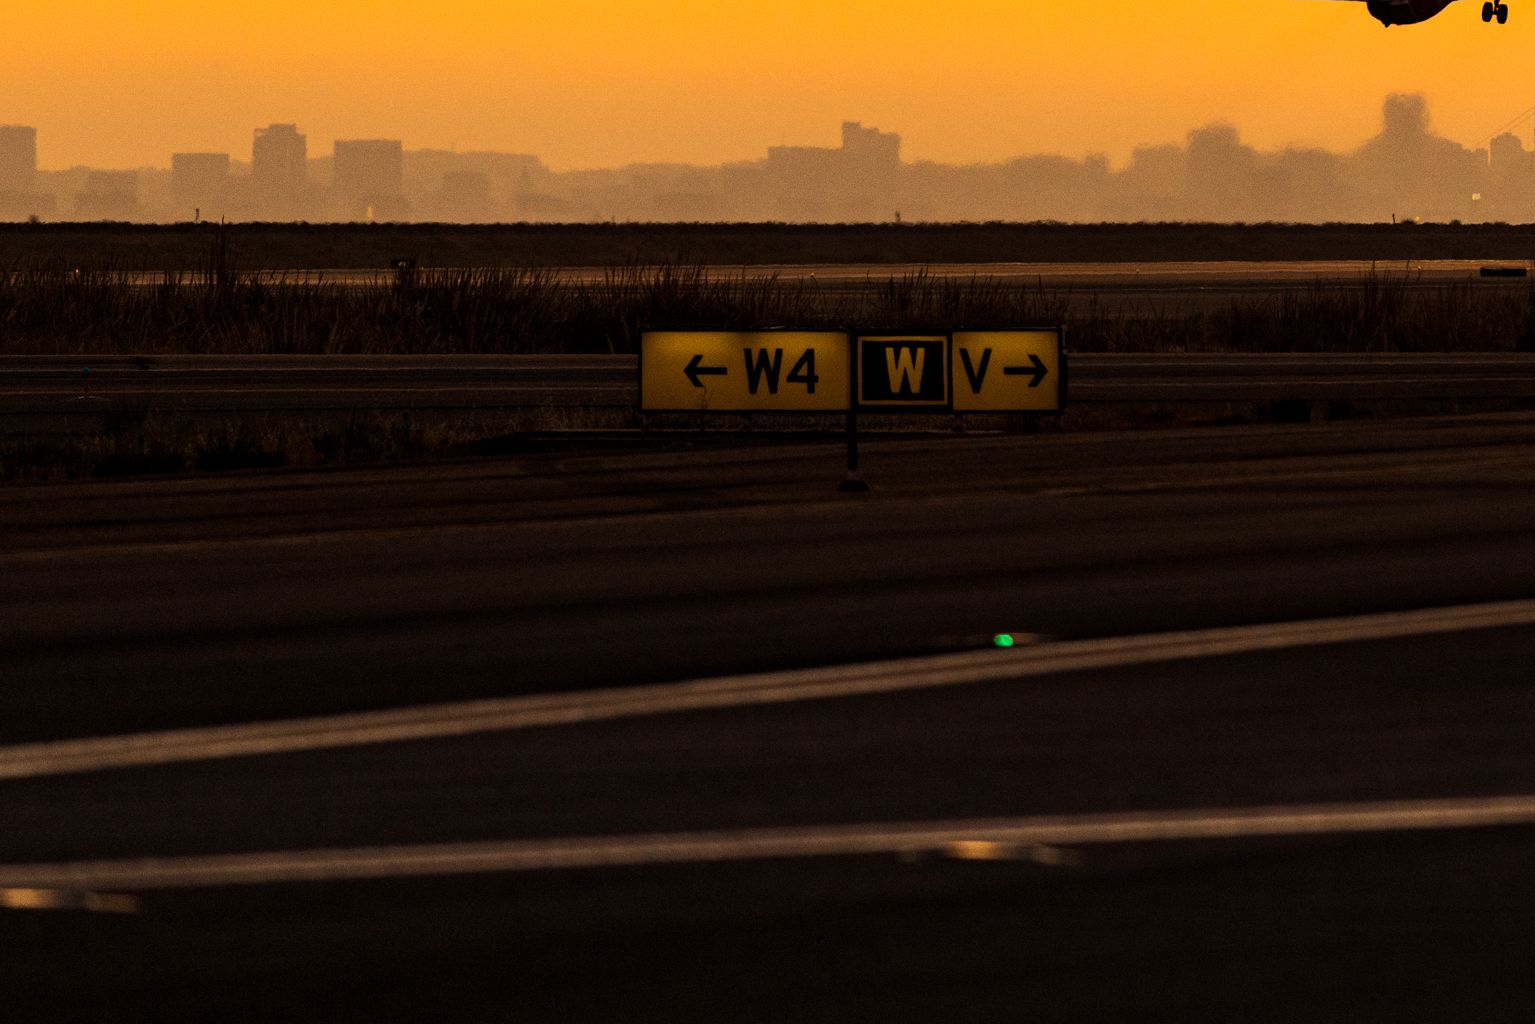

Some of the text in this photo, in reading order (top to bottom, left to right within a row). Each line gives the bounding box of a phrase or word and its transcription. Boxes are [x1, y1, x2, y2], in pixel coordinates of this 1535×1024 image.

[744, 346, 992, 394] W4 W V
